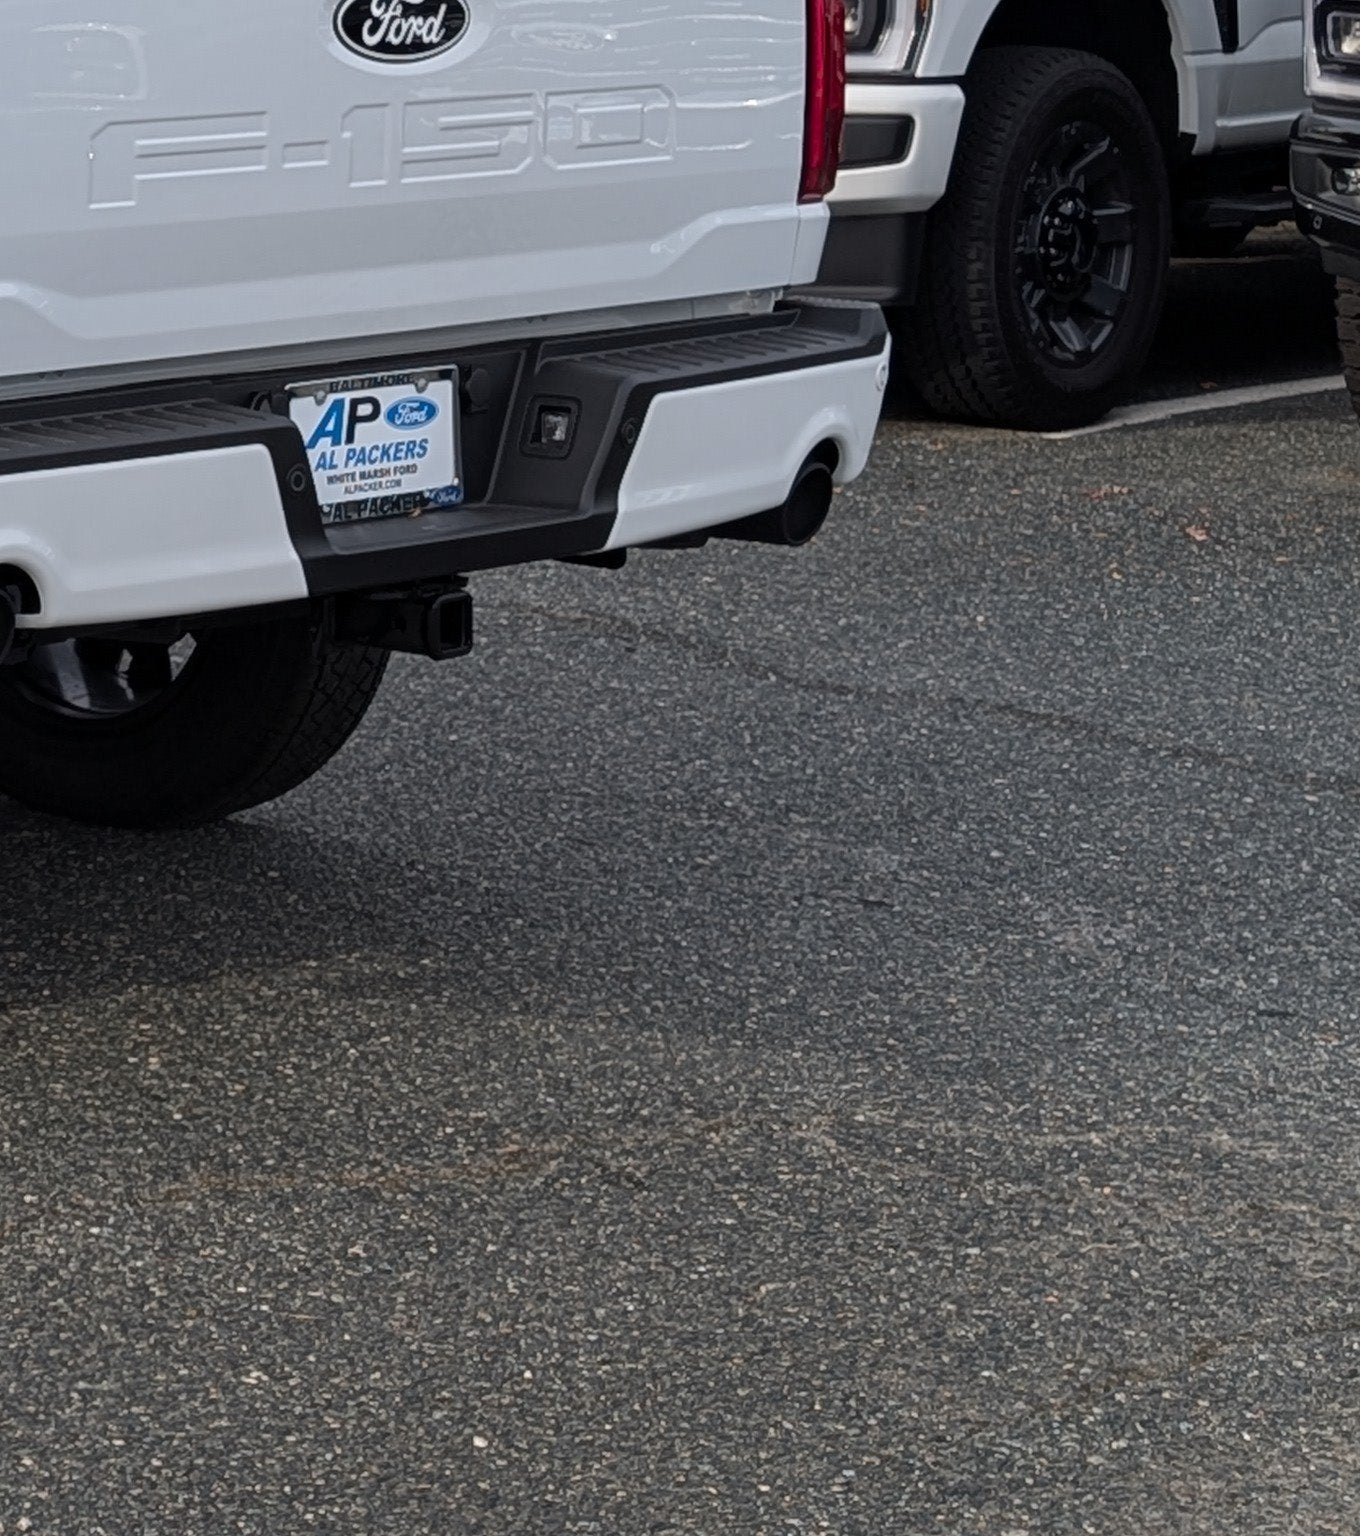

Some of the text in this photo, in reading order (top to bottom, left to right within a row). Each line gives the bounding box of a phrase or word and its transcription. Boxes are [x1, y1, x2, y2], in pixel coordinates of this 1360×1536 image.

[87, 83, 676, 209] F-150
[307, 395, 381, 450] AP
[314, 438, 429, 472] AL PACKERS
[326, 463, 418, 485] WHITE MARSH FORD
